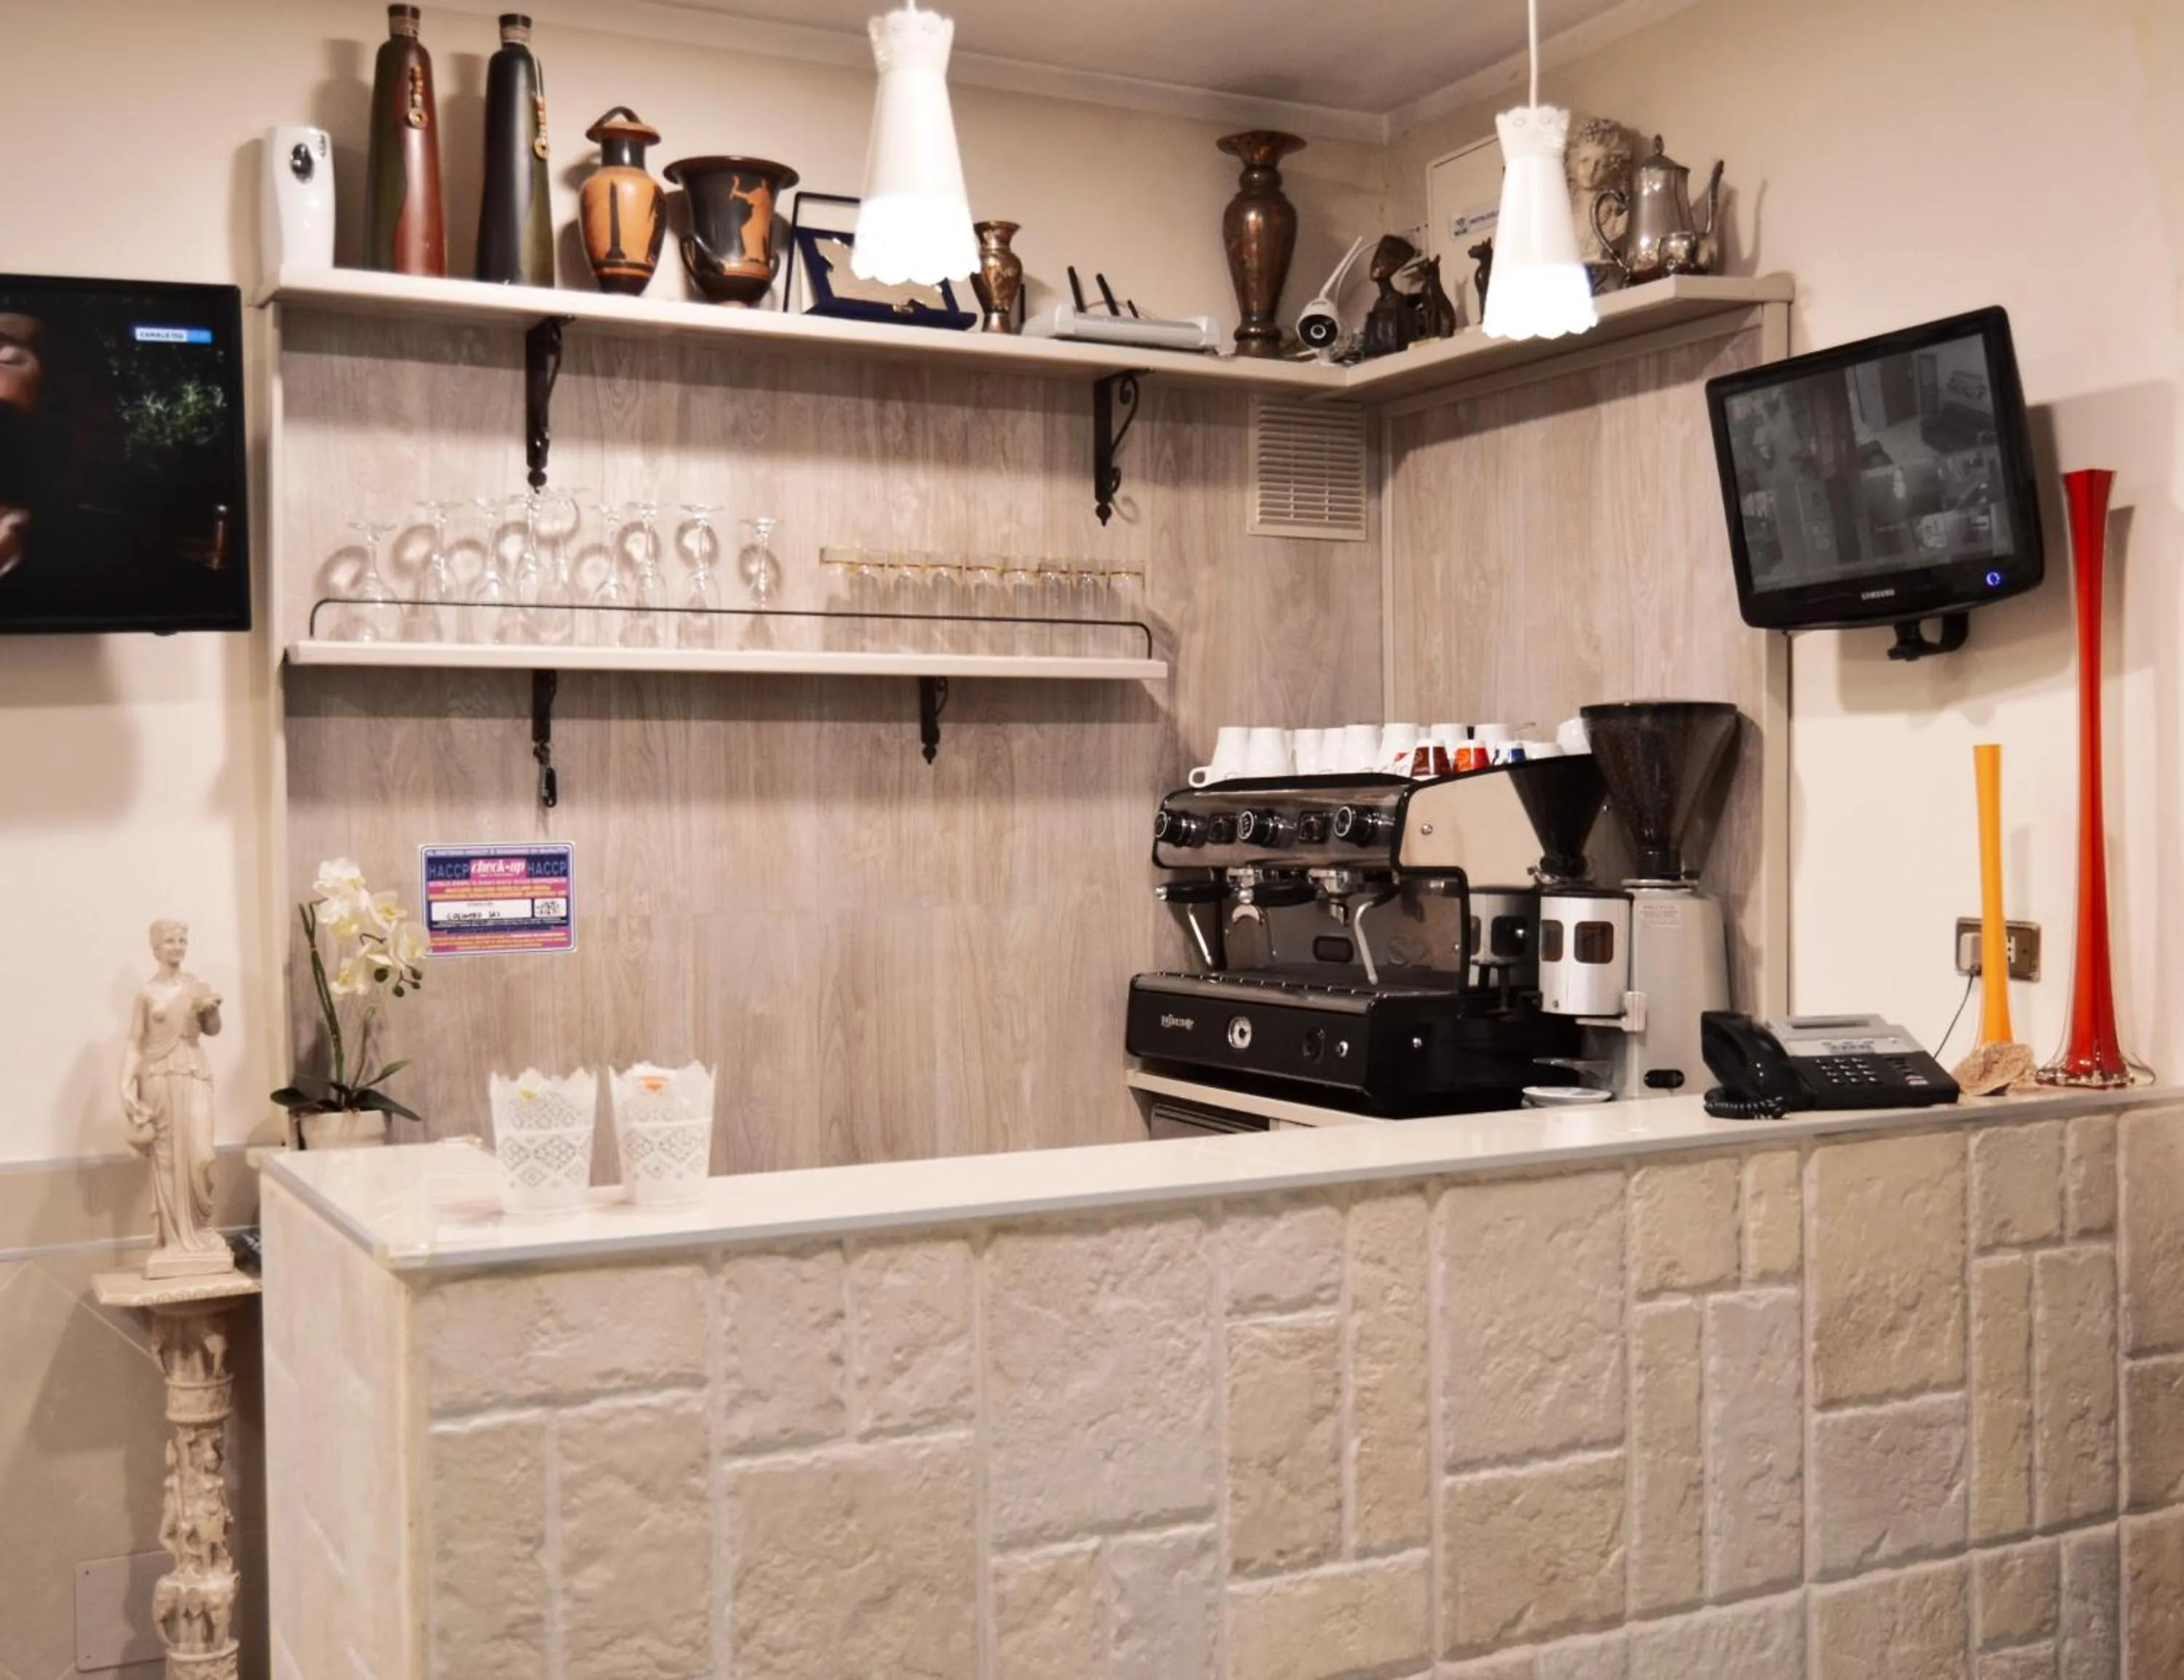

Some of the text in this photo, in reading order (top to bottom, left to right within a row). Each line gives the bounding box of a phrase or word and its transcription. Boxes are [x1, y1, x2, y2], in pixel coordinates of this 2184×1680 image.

[429, 859, 567, 879] HACCP check-up HACCP
